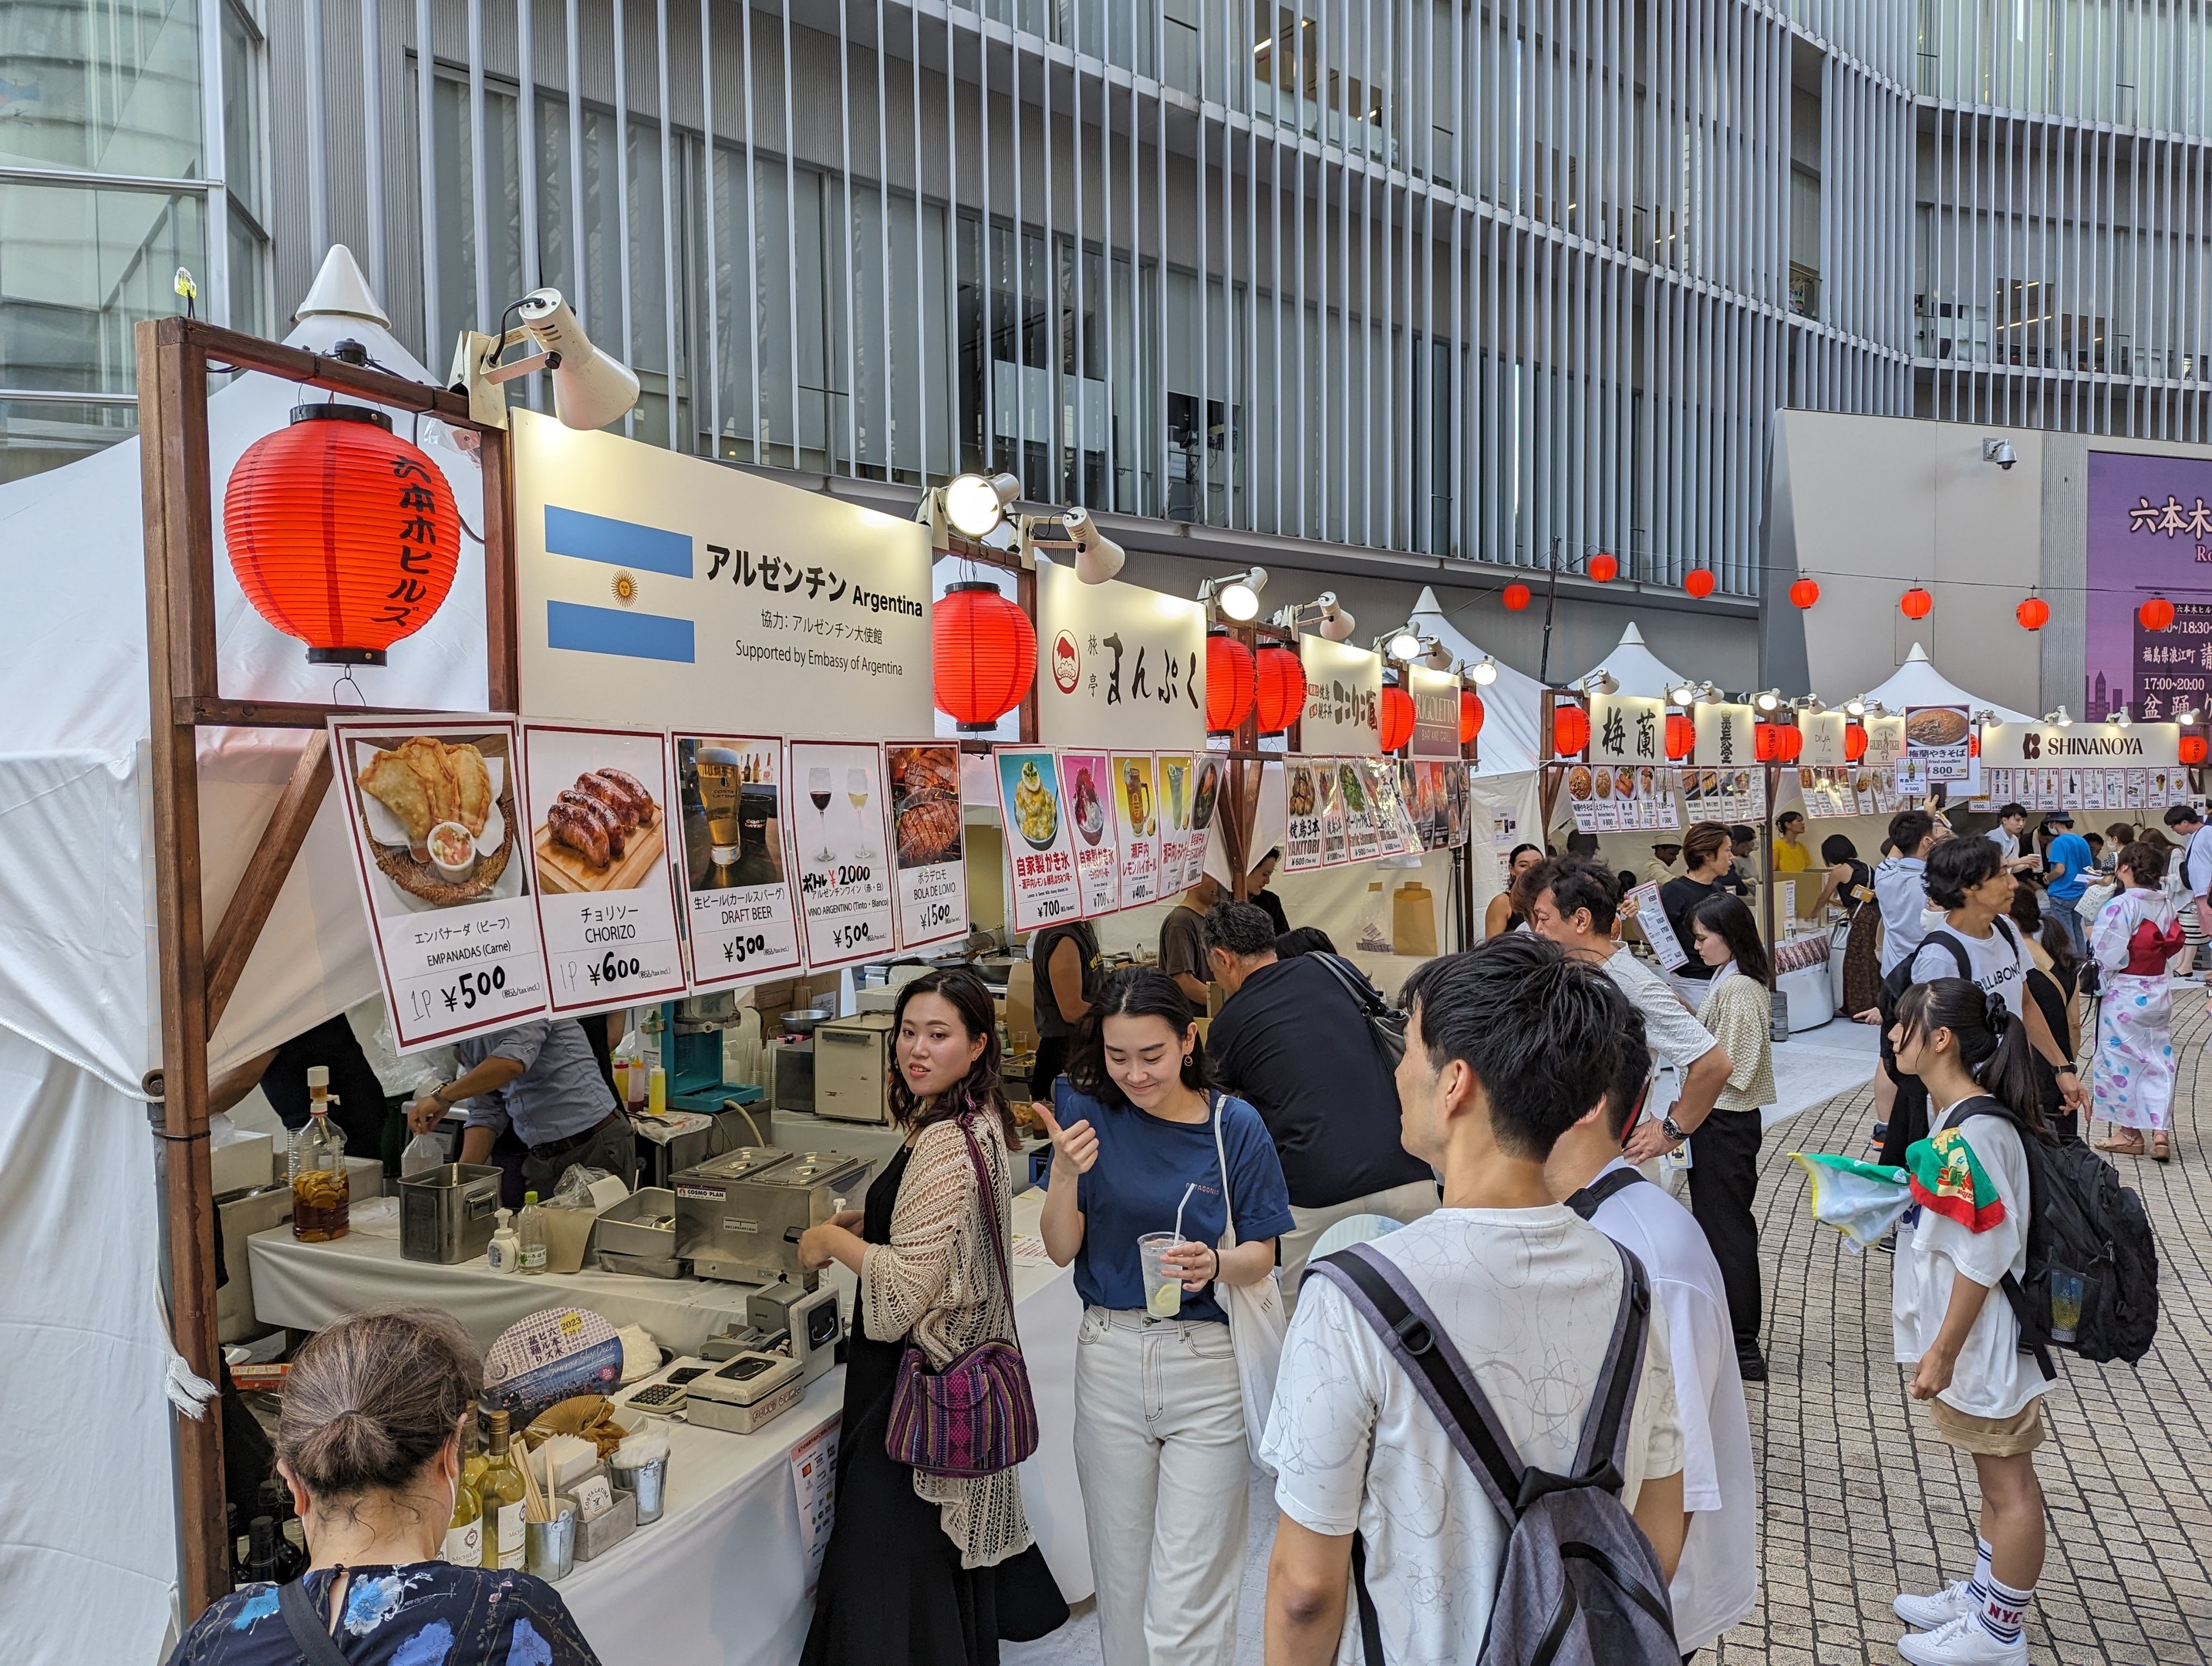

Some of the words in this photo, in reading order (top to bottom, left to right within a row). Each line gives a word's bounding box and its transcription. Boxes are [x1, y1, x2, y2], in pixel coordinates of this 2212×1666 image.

[372, 454, 436, 626] 六本木ヒルズ
[706, 543, 847, 602] アルゼンチン
[852, 585, 922, 617] Argentina
[736, 639, 791, 662] Supported
[794, 643, 806, 667] by
[809, 649, 848, 673] Embassy
[851, 656, 861, 669] of
[862, 657, 902, 676] Argentina
[2143, 646, 2196, 663] 福島県浪江町
[1087, 634, 1098, 698] 旅亭
[1103, 632, 1199, 710] まんぷく
[1417, 693, 1456, 723] RIGOLETTO
[1421, 729, 1430, 741] BAR
[1431, 730, 1439, 741] AND
[1440, 731, 1451, 743] GRILL
[1602, 706, 1655, 760] 梅蘭
[1908, 748, 1967, 758] 梅蘭やきそば
[2048, 737, 2143, 755] SHINANOYA
[1290, 817, 1320, 839] 焼鳥3本
[1131, 841, 1149, 858] 瀬戸内
[1288, 838, 1320, 857] YAKITORI
[1017, 850, 1070, 878] 自家製かき氷
[1292, 857, 1305, 866] ¥600
[914, 887, 929, 901] BOLA
[930, 885, 939, 896] DE
[939, 882, 956, 895] LOMO
[1093, 892, 1106, 908] ¥700
[1132, 885, 1145, 899] ¥400
[581, 905, 639, 923] チョリソー
[721, 909, 750, 925] DRAFT
[752, 906, 773, 920] BEER
[808, 906, 821, 916] VINO
[822, 902, 852, 915] ARGENTINO
[920, 903, 949, 930] ¥1500
[1037, 899, 1060, 918] ¥700
[585, 924, 636, 943] CHORIZO
[833, 922, 868, 949] ¥500
[427, 946, 481, 966] EMPANADAS
[483, 940, 511, 957] (Carne)
[723, 934, 765, 963] ¥500
[587, 951, 640, 986] ¥600
[440, 966, 506, 1013] ¥500
[1185, 1182, 1219, 1196] PTAGONIA
[560, 1317, 582, 1330] 2023
[528, 1335, 542, 1364] 盆踊り
[547, 1327, 565, 1357] 六本木
[548, 1357, 579, 1379] Summer
[580, 1349, 595, 1363] Sky
[596, 1340, 616, 1357] Deck
[585, 1491, 595, 1510] COSTA
[595, 1488, 609, 1499] LATINA
[1988, 1602, 2023, 1624] NYC
